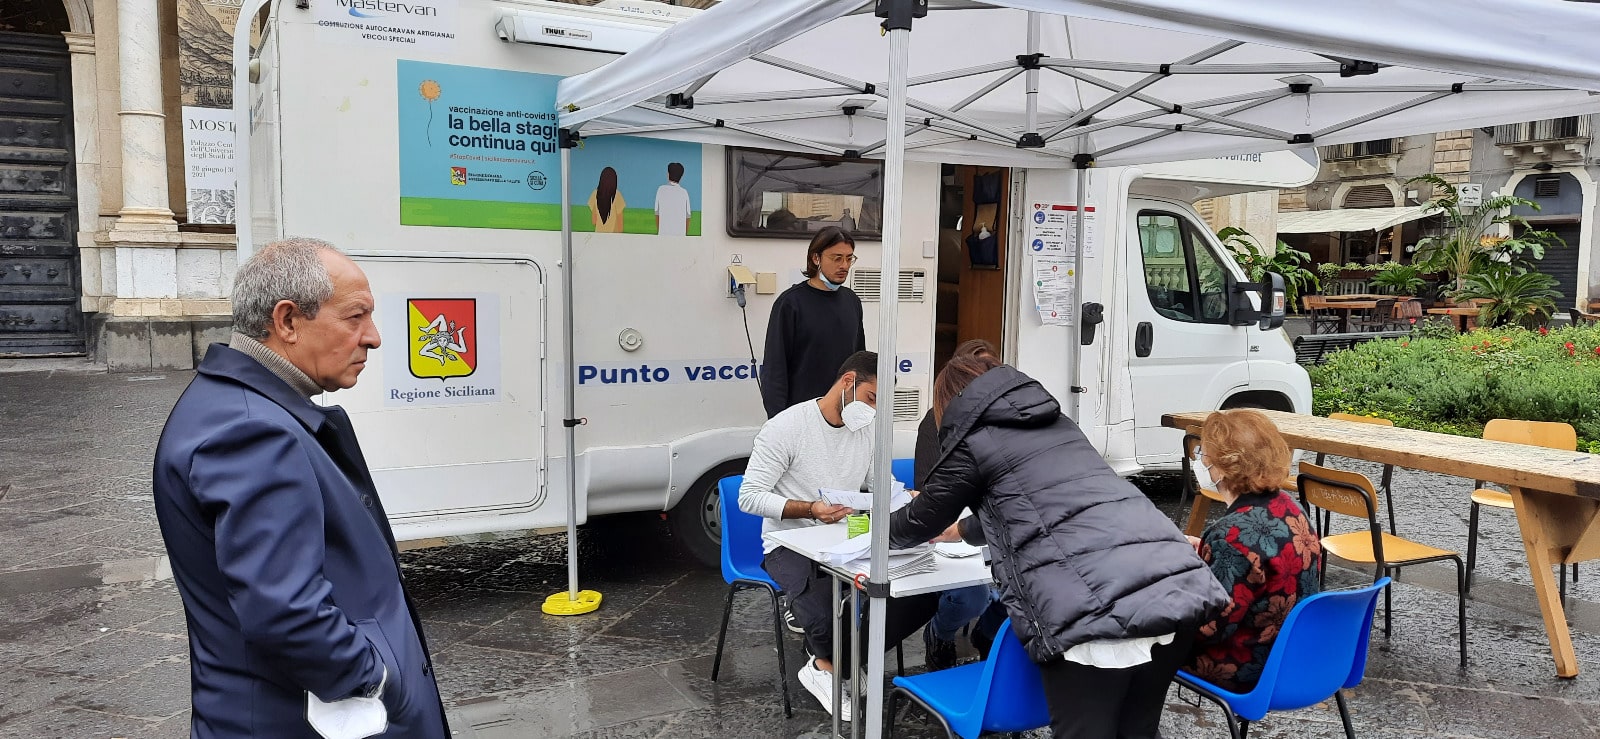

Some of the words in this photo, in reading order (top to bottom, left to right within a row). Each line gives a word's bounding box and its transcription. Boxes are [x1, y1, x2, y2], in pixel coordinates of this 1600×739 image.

[318, 20, 363, 30] COSTRUZIONE
[365, 25, 416, 35] AUTOCARAVAN
[416, 30, 455, 39] ARTIGIANALI
[545, 27, 565, 35] THULE
[361, 33, 388, 41] VEICOLI
[449, 106, 504, 117] vaccinazione
[506, 110, 556, 120] anti-covid19
[449, 114, 464, 130] la
[469, 116, 511, 133] bella
[516, 121, 557, 140] stagi
[190, 139, 216, 147] Palazzo
[449, 134, 525, 151] continua
[530, 139, 556, 155] qui
[190, 151, 207, 159] degli
[201, 165, 223, 173] giugno
[578, 364, 670, 384] Punto
[390, 388, 440, 402] Regione
[444, 385, 495, 397] Siciliana
